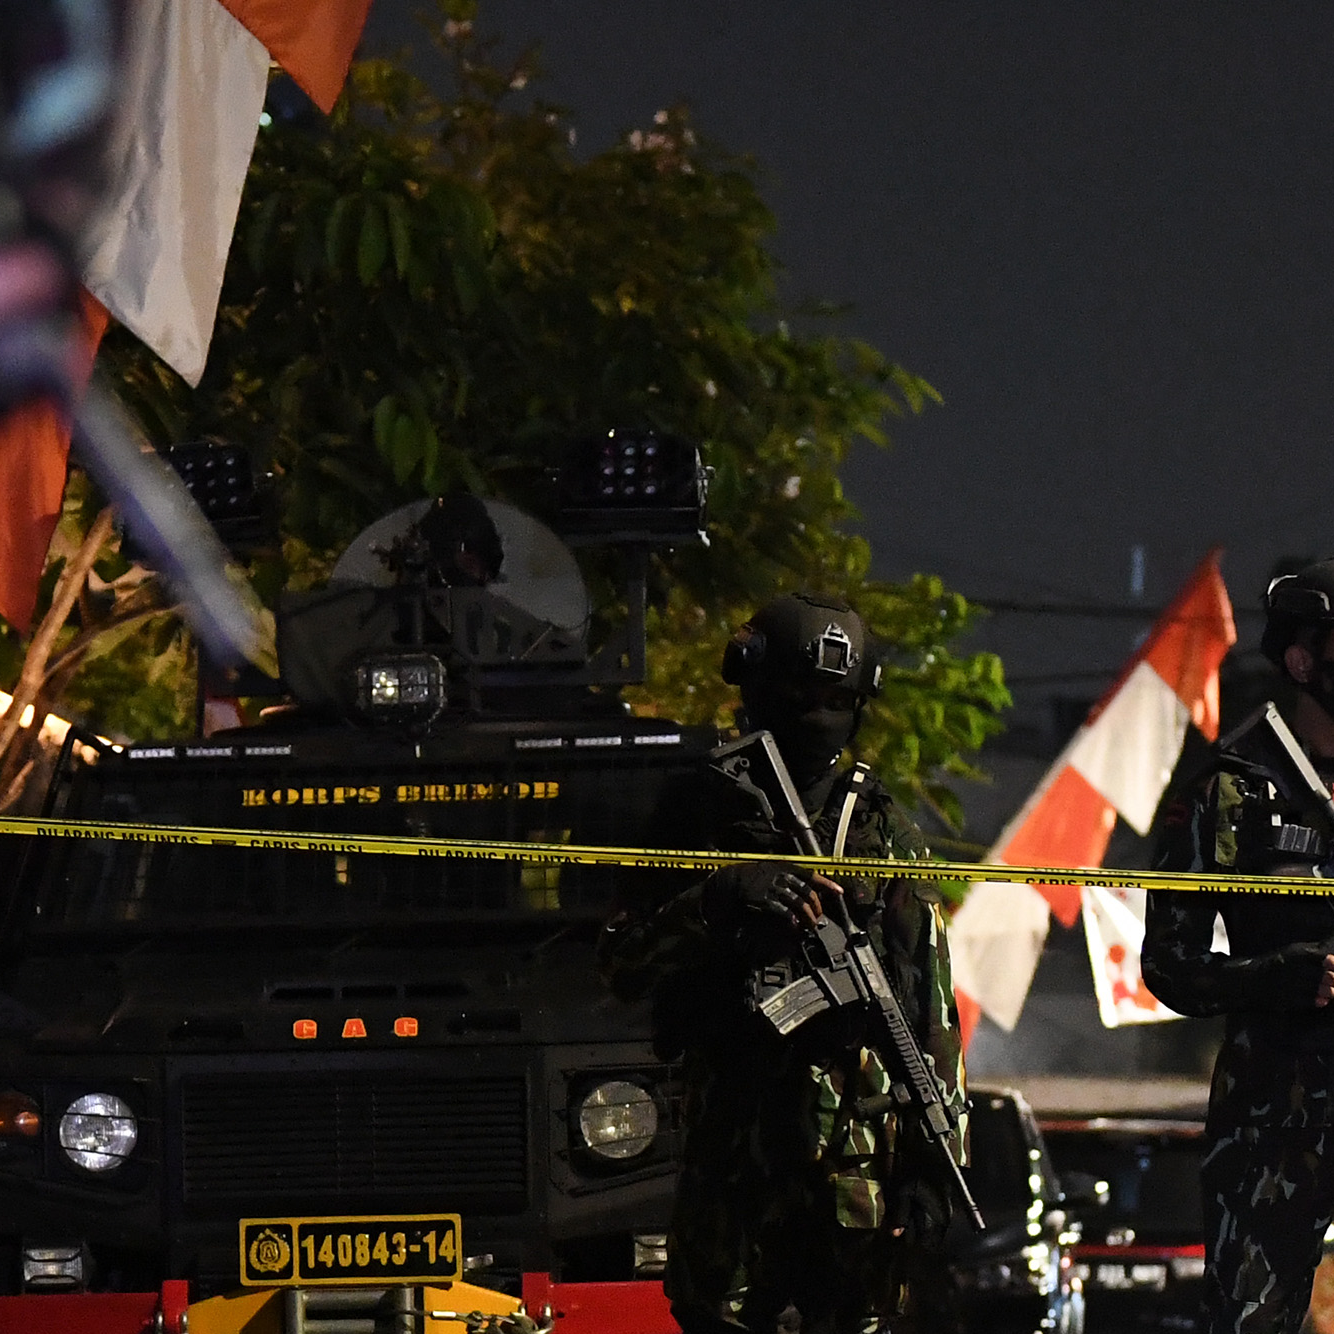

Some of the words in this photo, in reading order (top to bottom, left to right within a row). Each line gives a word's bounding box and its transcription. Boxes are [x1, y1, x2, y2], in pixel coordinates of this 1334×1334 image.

[241, 785, 381, 807] KORPS
[397, 781, 560, 803] BRIMOB
[301, 1229, 457, 1269] 140843-14
